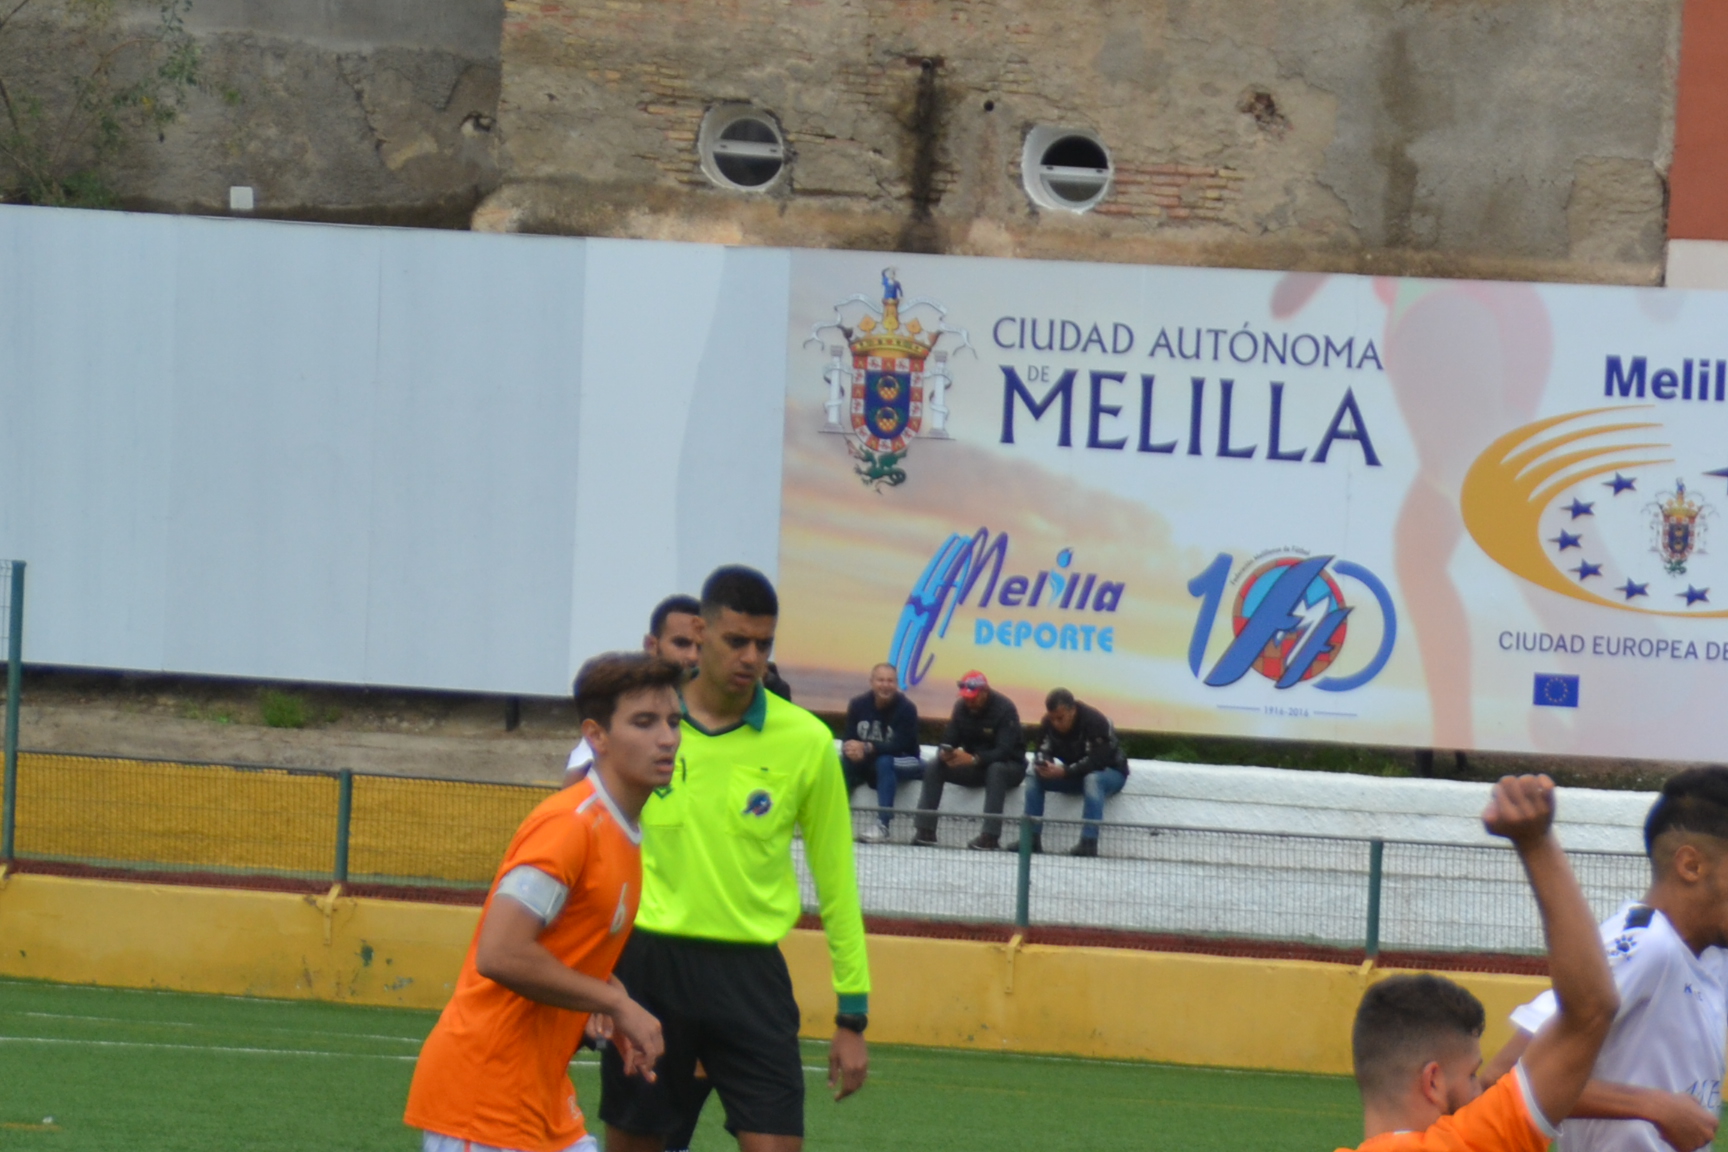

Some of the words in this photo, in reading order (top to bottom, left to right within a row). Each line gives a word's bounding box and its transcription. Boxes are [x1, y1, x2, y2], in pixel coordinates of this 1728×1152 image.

[992, 316, 1135, 354] CIUDAD
[1148, 321, 1384, 371] AUTÓNOMA
[1027, 364, 1050, 383] DE
[998, 364, 1383, 467] MELILLA
[957, 526, 1126, 614] Melilla
[973, 618, 1114, 653] DEPORTE
[1498, 630, 1586, 654] CIUDAD
[1592, 635, 1699, 660] EUROPEA
